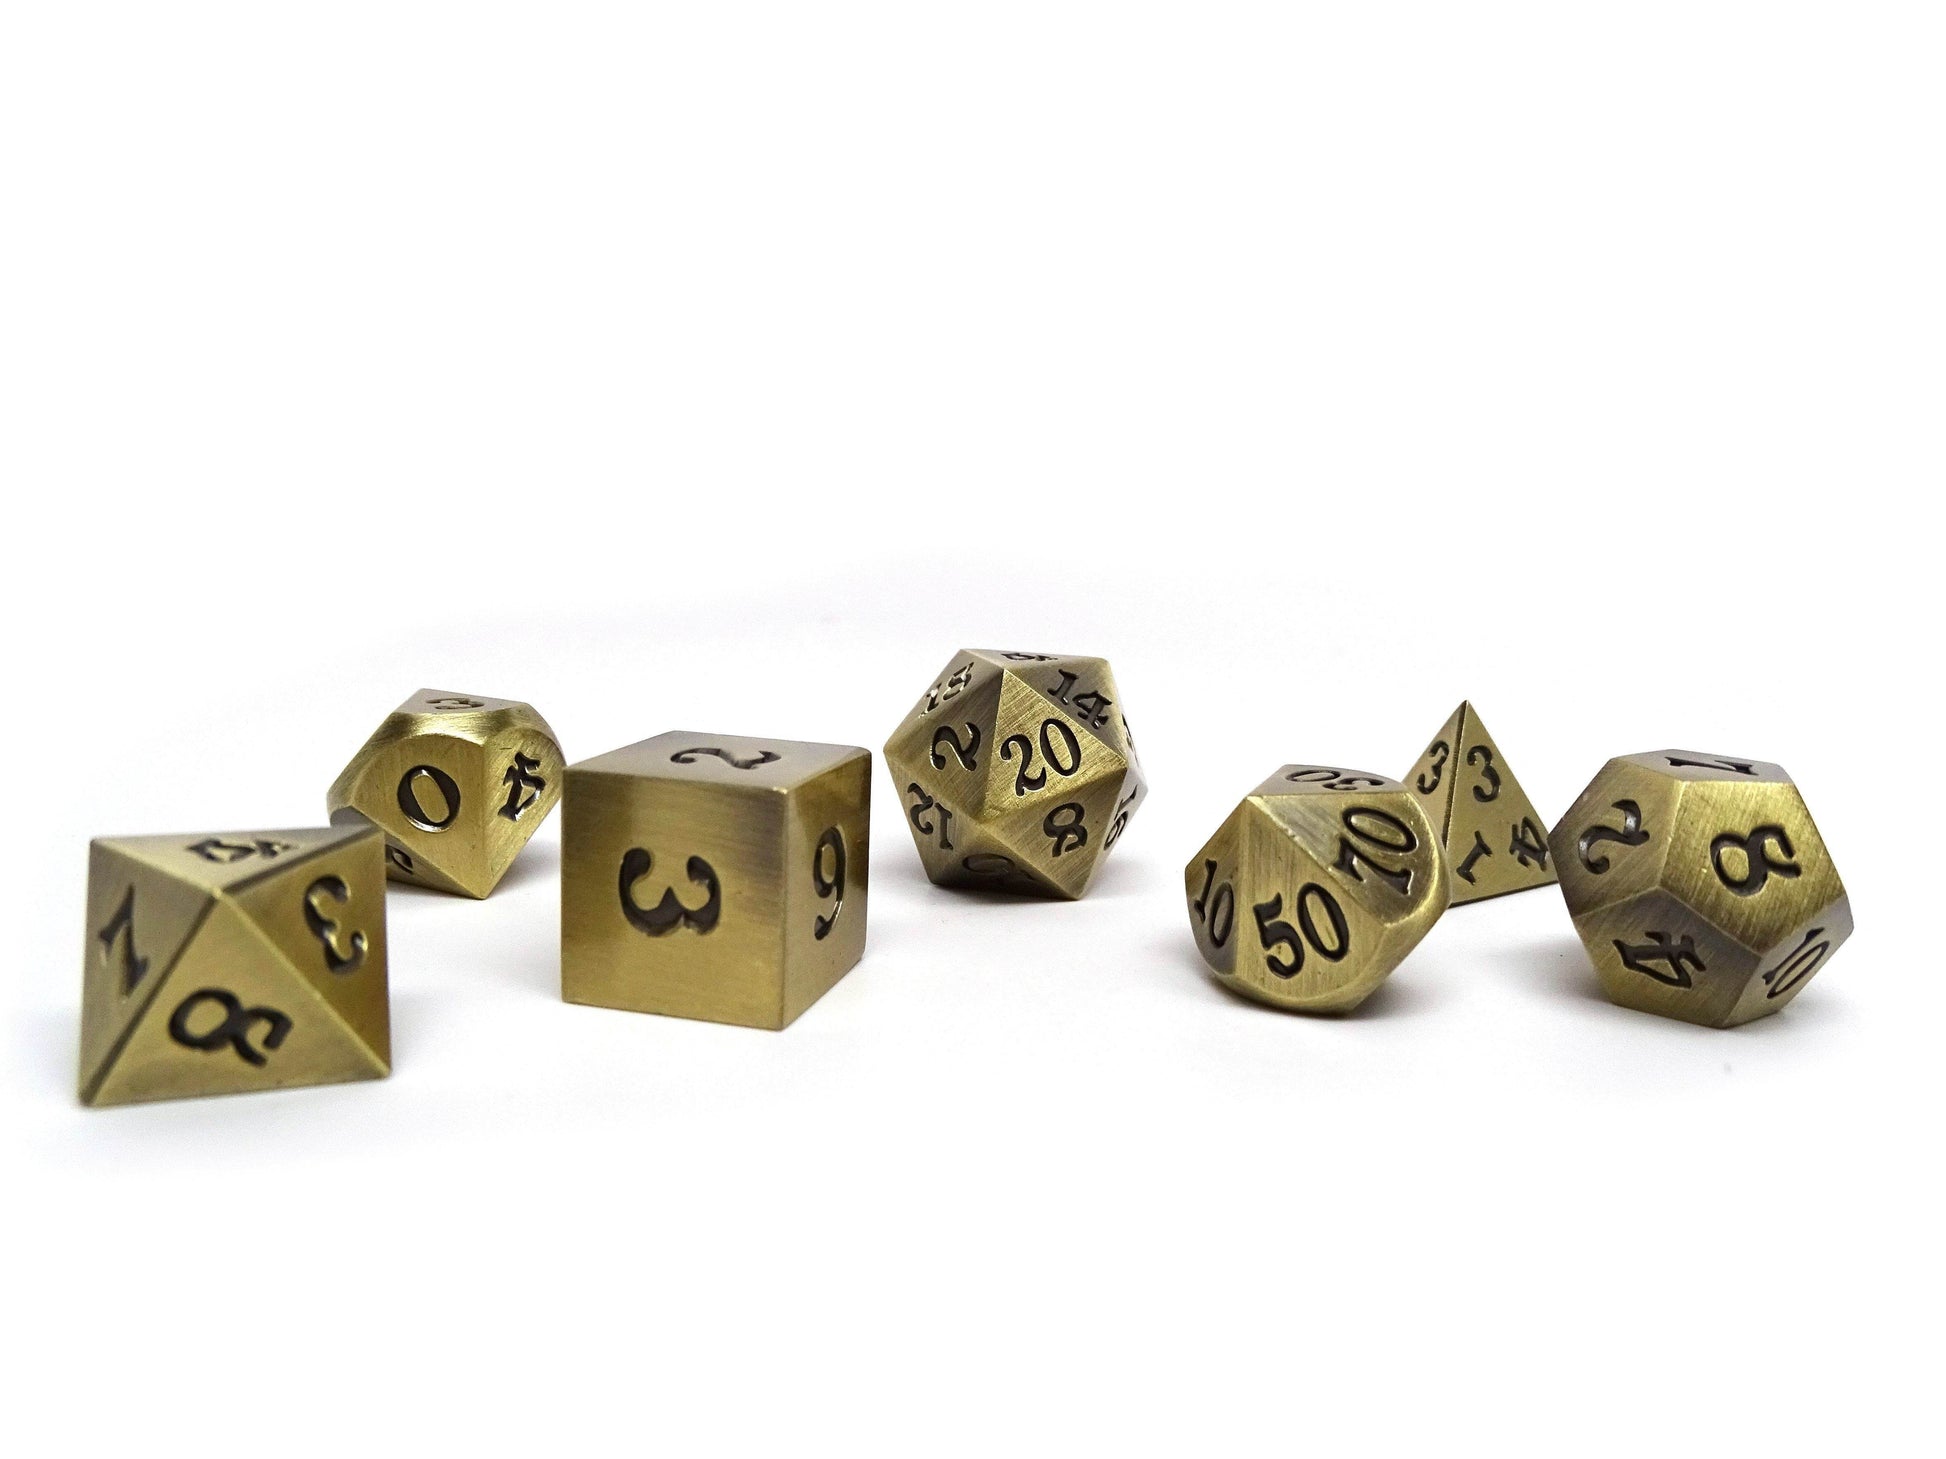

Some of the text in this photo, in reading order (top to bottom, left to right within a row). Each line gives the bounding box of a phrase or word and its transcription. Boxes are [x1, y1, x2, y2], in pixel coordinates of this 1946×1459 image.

[1047, 669, 1113, 730] 14
[670, 747, 782, 769] 2
[929, 722, 981, 771] 2
[1000, 718, 1082, 798] 20
[1285, 769, 1385, 791] 30
[1416, 740, 1450, 794] 3
[1466, 745, 1501, 802] 3
[397, 764, 461, 833] 0
[498, 752, 547, 822] 4
[907, 783, 954, 850] 12
[1043, 802, 1088, 857] 8
[1332, 807, 1418, 896] 70
[1456, 831, 1494, 885] 1
[1509, 816, 1549, 872] 4
[1578, 799, 1650, 875] 2
[1710, 824, 1802, 897] 8
[303, 873, 370, 974] 3
[618, 848, 722, 938] 3
[1194, 858, 1234, 948] 10
[1253, 882, 1350, 979] 50
[1612, 931, 1707, 989] 4
[1761, 927, 1830, 999] 10
[168, 987, 294, 1067] 8
